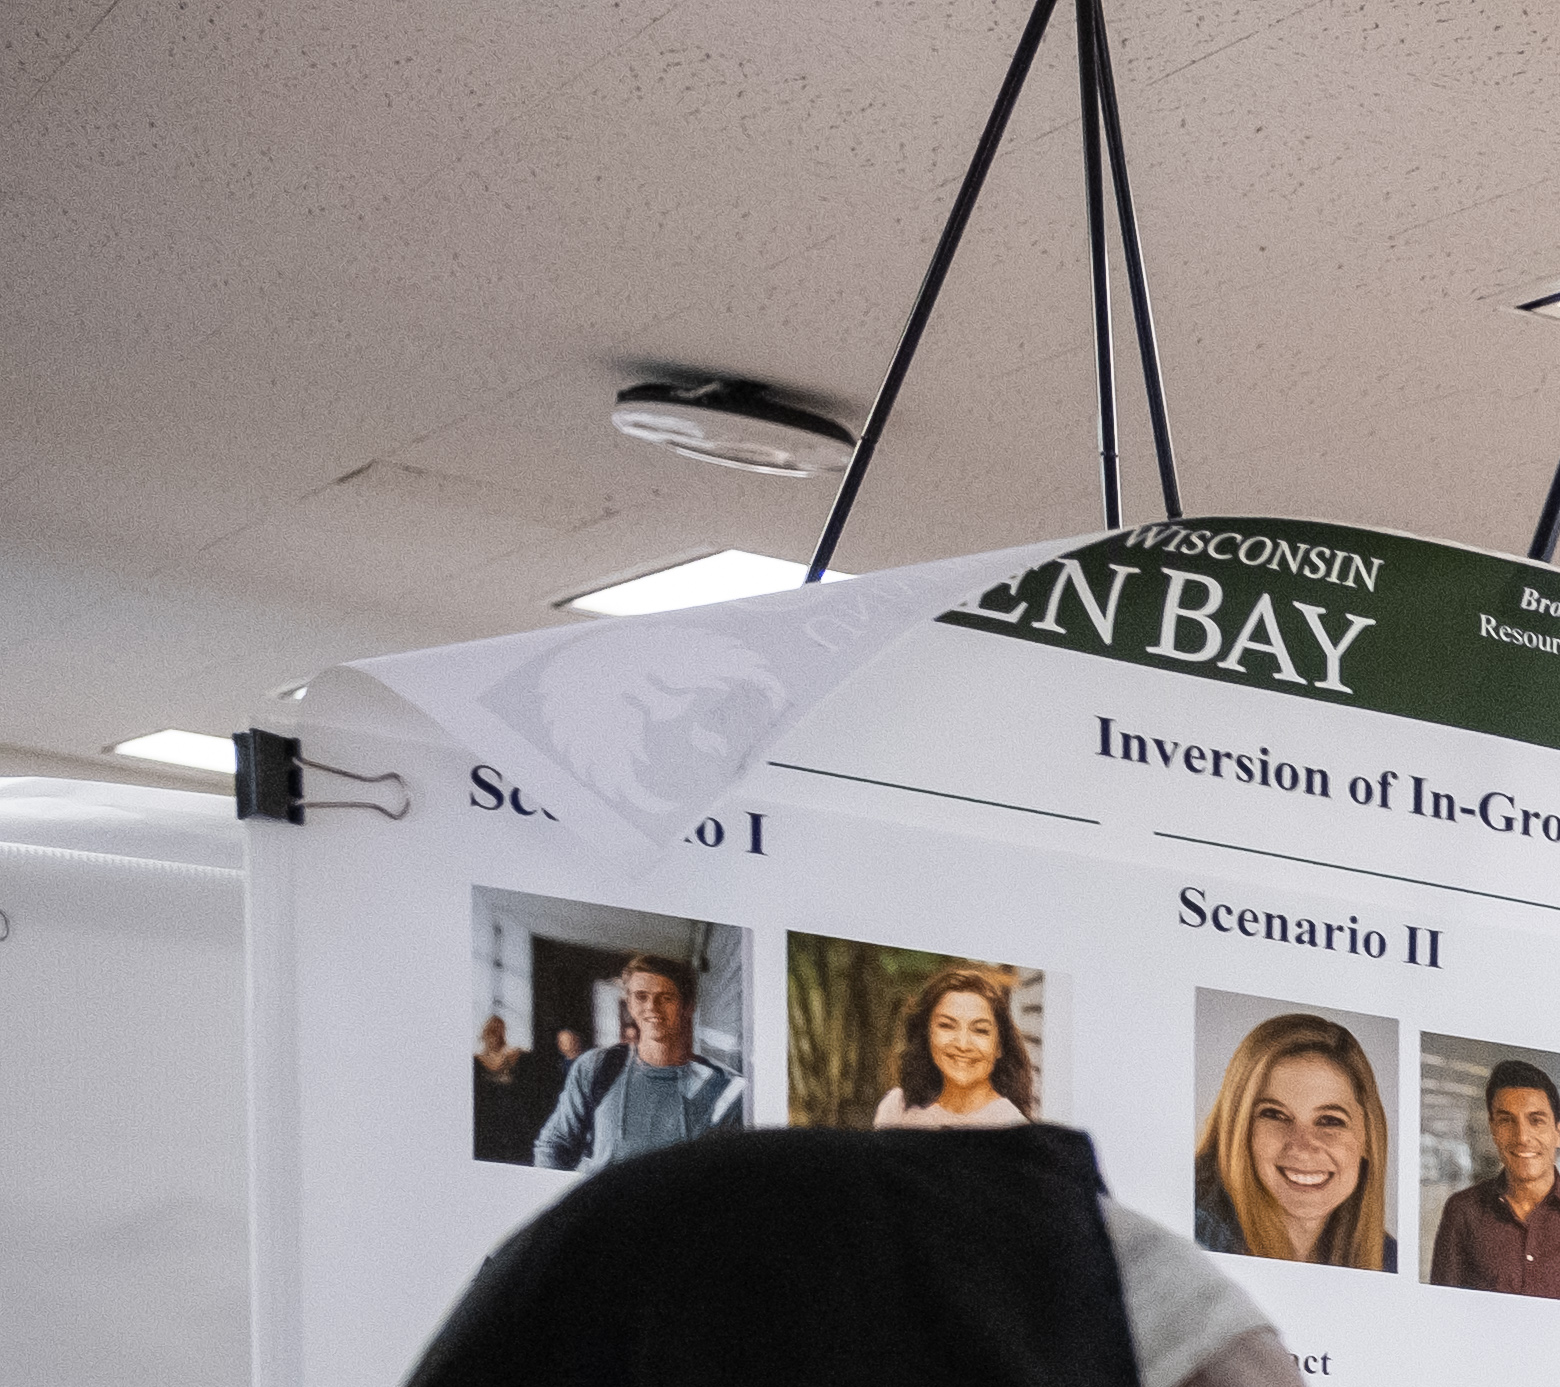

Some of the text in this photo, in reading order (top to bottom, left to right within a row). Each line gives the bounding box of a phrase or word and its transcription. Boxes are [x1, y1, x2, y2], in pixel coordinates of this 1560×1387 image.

[1123, 524, 1387, 593] WISCONSIN
[1144, 566, 1378, 694] BAY
[1094, 716, 1331, 799] Inversion
[1348, 770, 1399, 810] of
[1178, 887, 1443, 969] Scenario II
